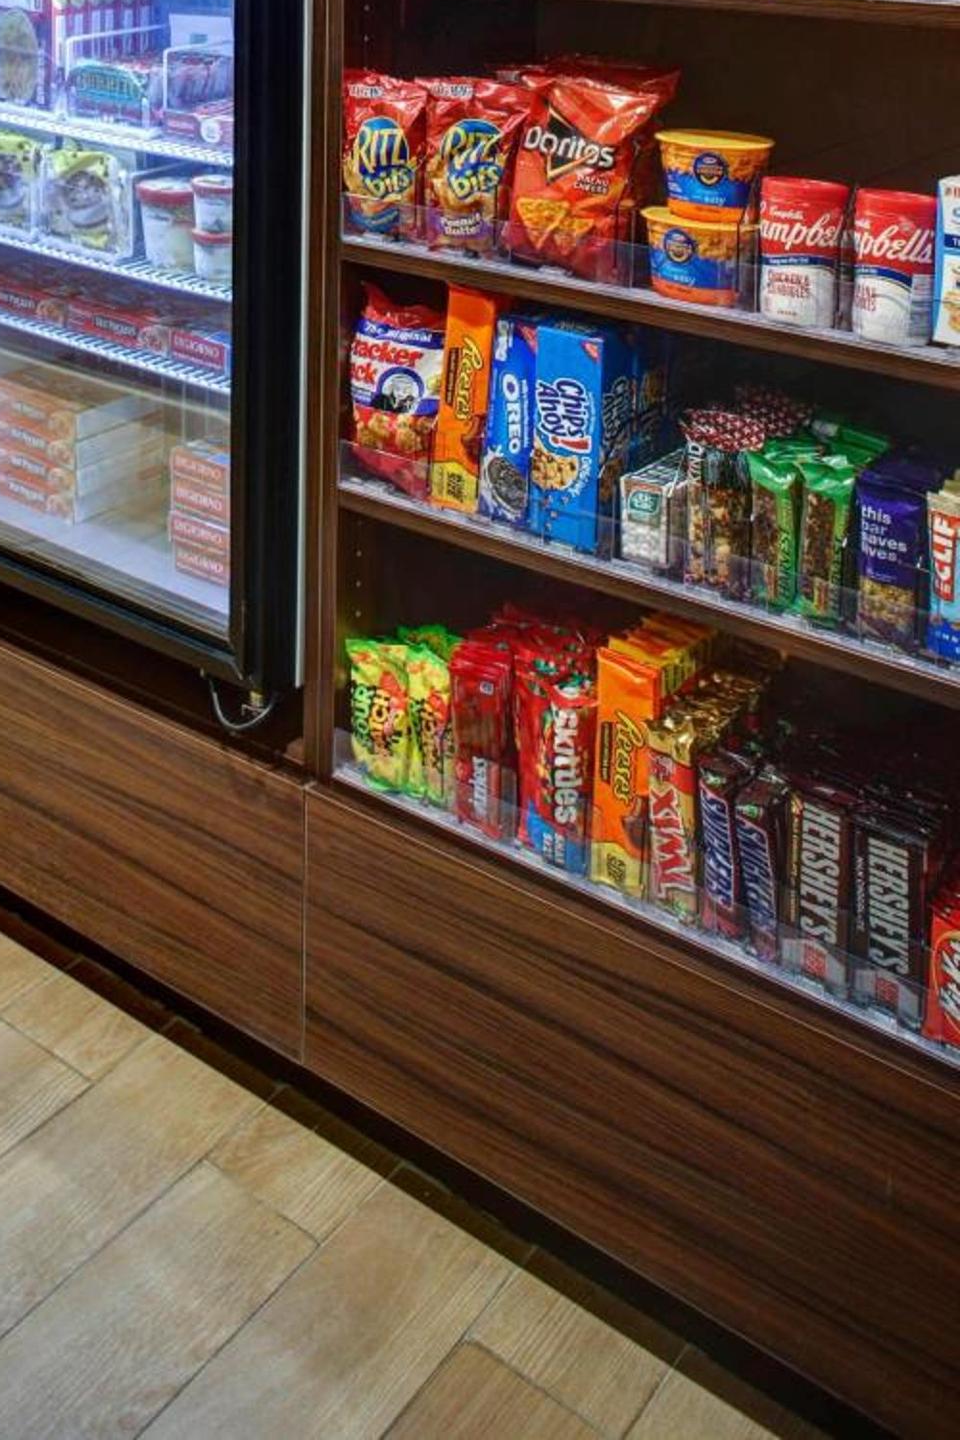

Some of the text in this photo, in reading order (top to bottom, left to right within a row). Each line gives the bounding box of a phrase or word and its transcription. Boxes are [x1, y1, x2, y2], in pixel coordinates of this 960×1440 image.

[353, 126, 408, 173] RITZ
[523, 126, 615, 168] Doritos
[502, 373, 522, 455] OREO
[552, 377, 587, 438] Chips
[862, 505, 892, 525] this
[862, 518, 887, 537] bar
[862, 532, 907, 553] saves
[933, 516, 955, 582] CLIF
[613, 710, 648, 806] Reese's
[649, 785, 697, 898] TWIX
[800, 800, 840, 945] HERSHEY'S
[868, 837, 910, 975] HERSHEY'S
